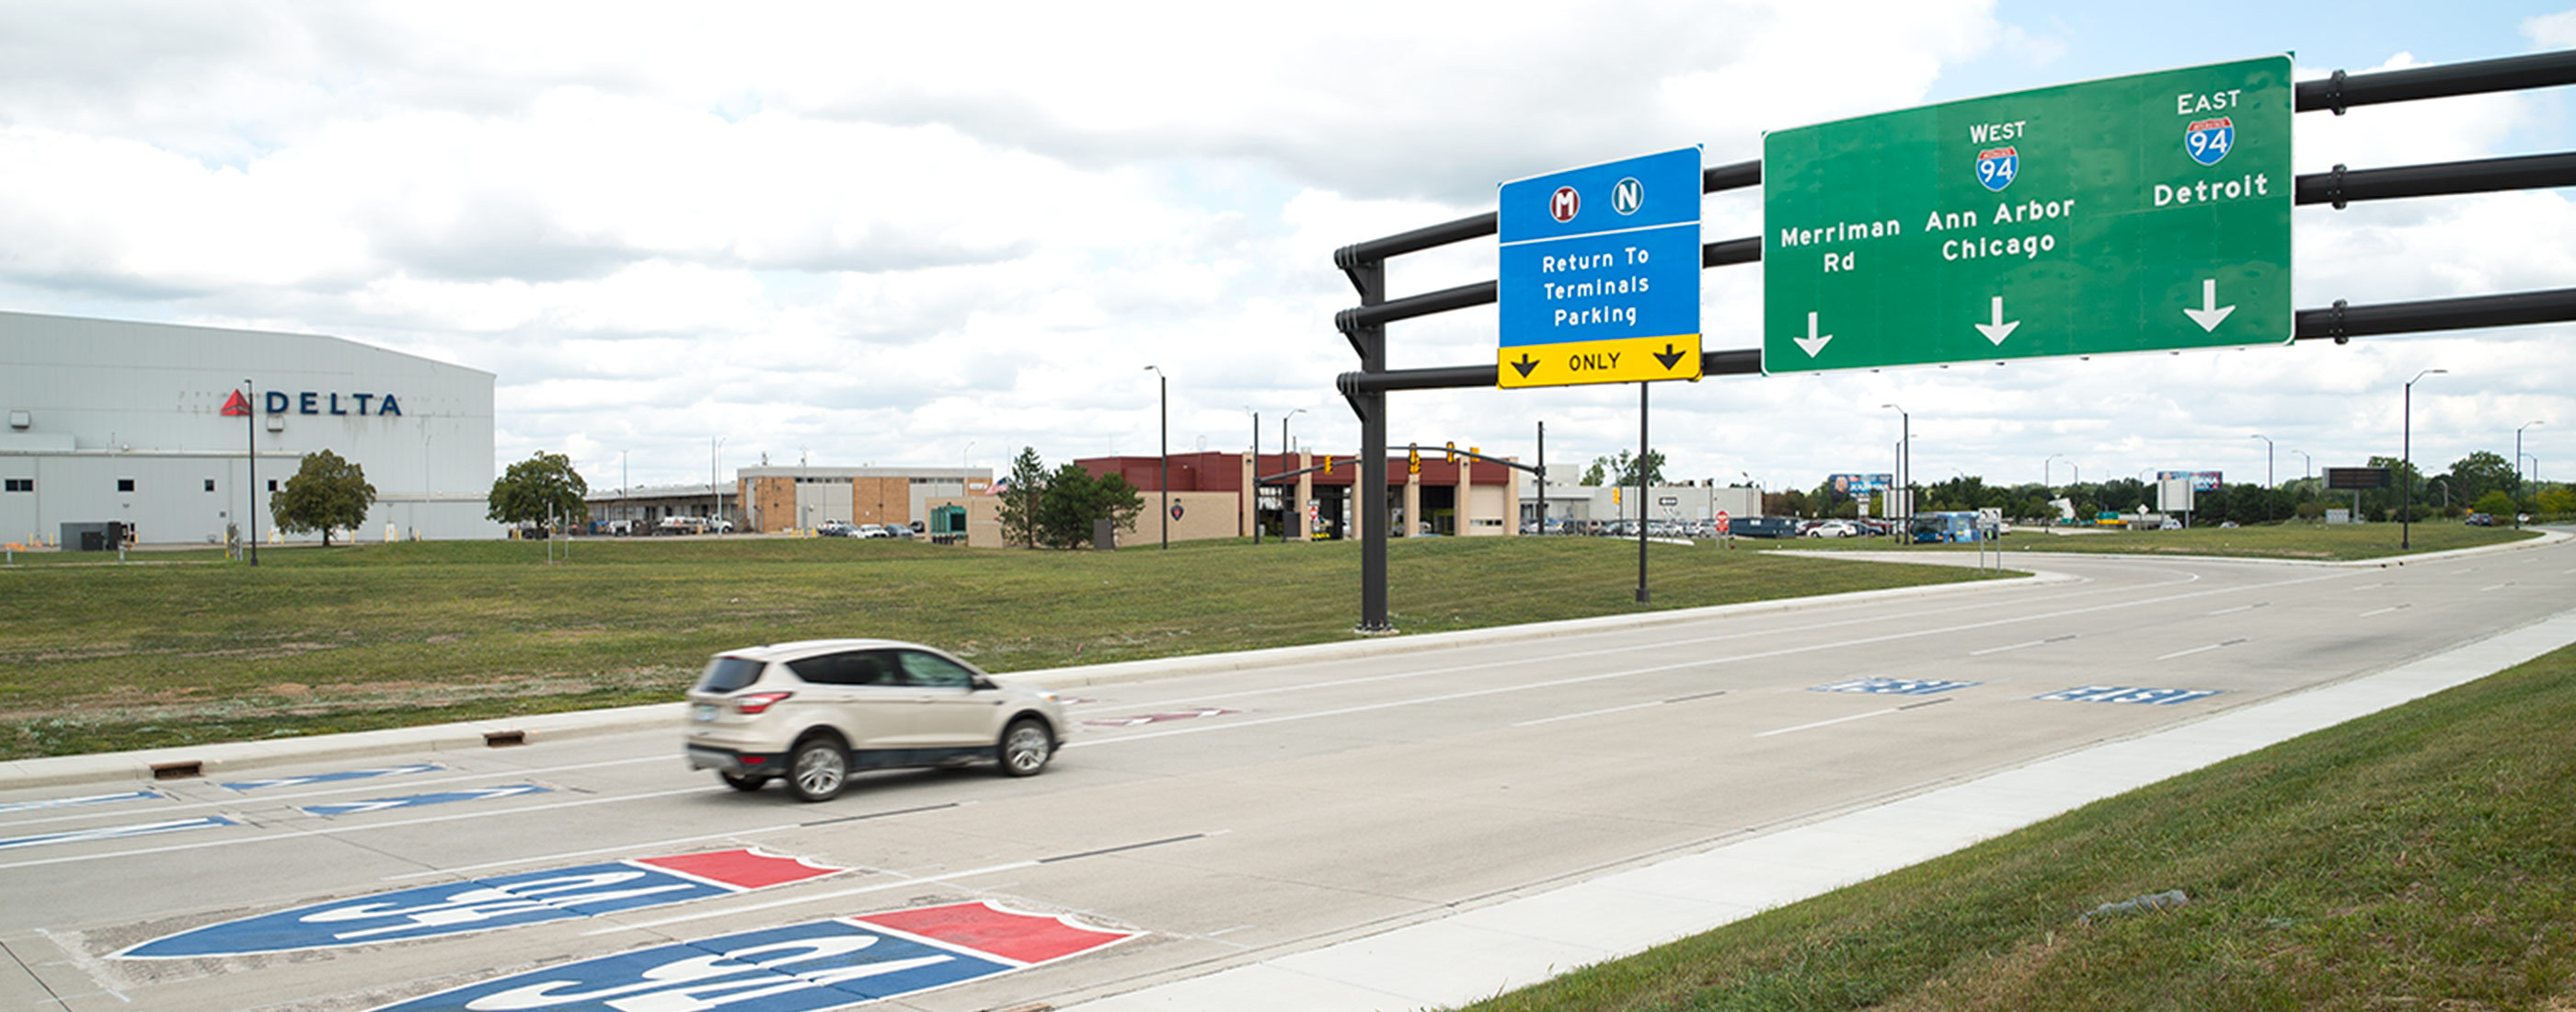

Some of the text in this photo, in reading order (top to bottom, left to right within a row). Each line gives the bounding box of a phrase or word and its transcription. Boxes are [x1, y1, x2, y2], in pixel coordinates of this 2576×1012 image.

[2178, 89, 2241, 115] EAST
[1970, 121, 2026, 144] WEST
[2190, 129, 2227, 156] 94
[1980, 157, 2013, 183] 94
[1555, 180, 1639, 218] M N
[2155, 173, 2268, 206] Detroit
[1926, 200, 2075, 232] Ann Arbor
[1781, 220, 1900, 247] Merriman
[1543, 247, 1649, 273] Return To
[1942, 235, 2055, 260] Chicago
[1824, 251, 1856, 272] Rd
[1544, 276, 1650, 300] Terminals
[1555, 305, 1636, 327] Parking
[1570, 352, 1621, 372] ONLY
[266, 391, 402, 416] DELTA
